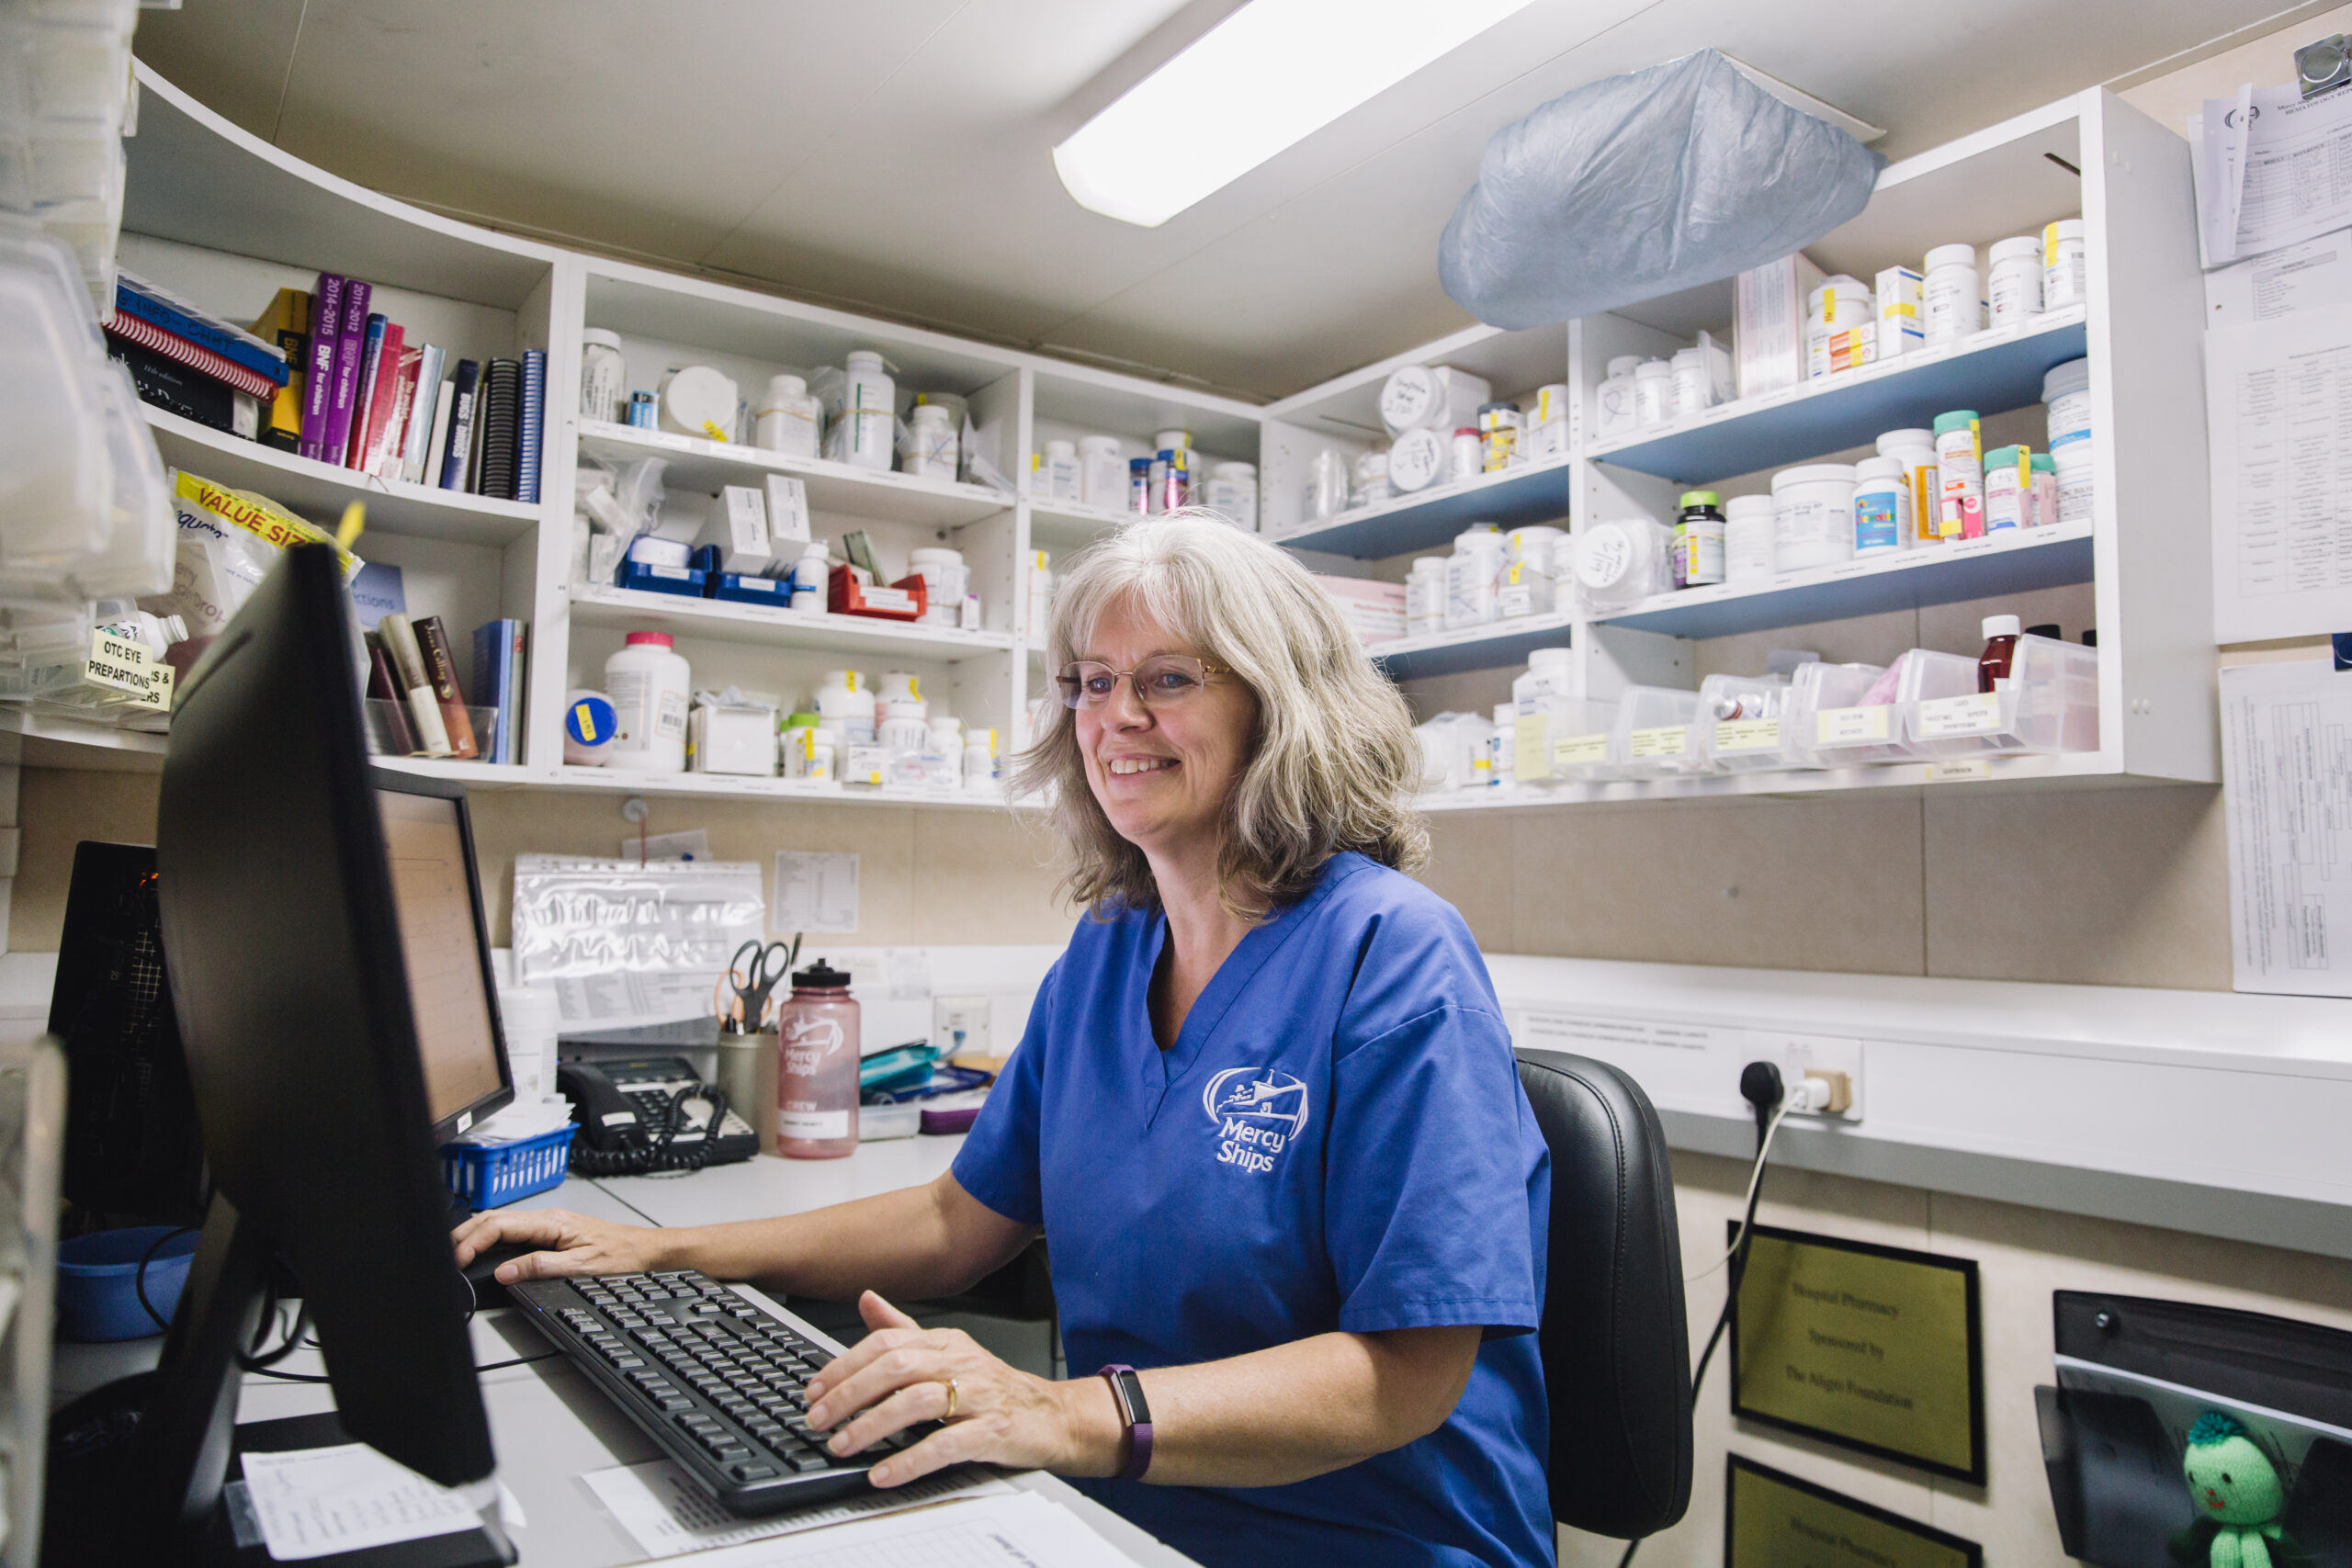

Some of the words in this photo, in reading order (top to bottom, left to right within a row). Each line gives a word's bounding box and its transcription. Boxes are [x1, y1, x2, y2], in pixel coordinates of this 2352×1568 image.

[322, 277, 340, 336] 2014-2015
[347, 283, 365, 333] 2011-2012
[283, 336, 300, 367] BNF
[316, 344, 332, 372] BNF
[311, 383, 324, 416] children
[337, 378, 350, 410] children
[457, 392, 472, 421] BUGS
[451, 424, 469, 458] DRUGS
[199, 487, 266, 533] VALUE
[266, 525, 311, 550] SIZ
[104, 640, 123, 659] OTC
[125, 648, 141, 664] EYE
[88, 660, 151, 690] PREPARTIONS
[162, 672, 170, 684] &
[1217, 1116, 1285, 1154] Mercy
[1216, 1140, 1275, 1174] Ships
